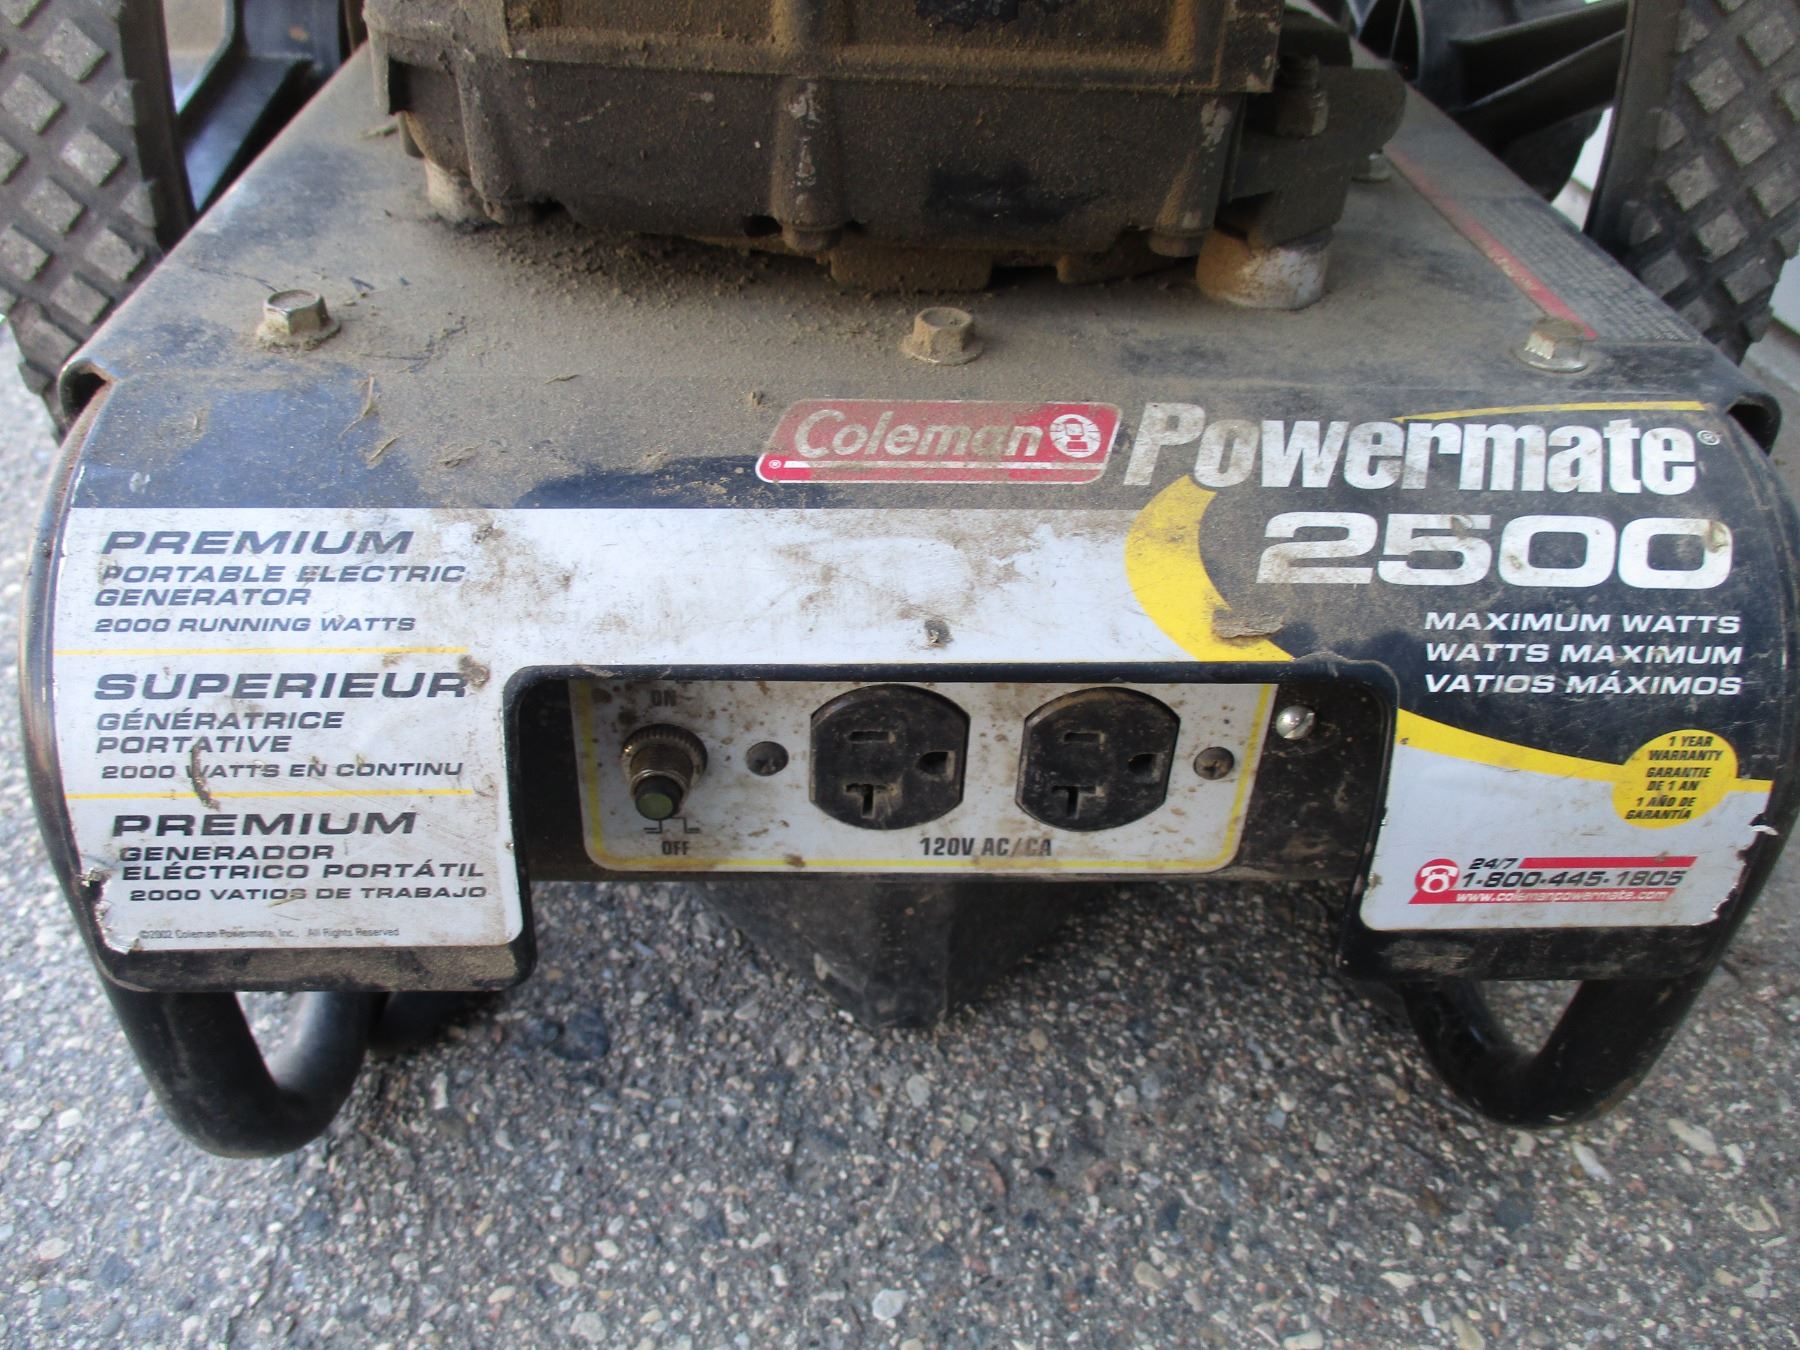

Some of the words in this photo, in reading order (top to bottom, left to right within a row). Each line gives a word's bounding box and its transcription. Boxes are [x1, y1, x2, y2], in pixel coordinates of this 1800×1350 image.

[794, 409, 1043, 457] Coleman
[102, 531, 414, 554] PREMIUM
[1256, 511, 1734, 590] 2500
[101, 566, 286, 583] PORTABLE
[298, 565, 466, 582] ELECTRIC
[95, 588, 312, 606] GENERATOR
[95, 618, 170, 632] 2000
[178, 618, 311, 632] RUNNING
[321, 617, 416, 631] WATTS
[1424, 612, 1607, 632] MAXIMUM
[1623, 614, 1742, 634] WATTS
[1426, 643, 1550, 663] WATTS
[1560, 644, 1743, 665] MAXIMUM
[1425, 674, 1556, 694] VATIOS
[1566, 669, 1742, 695] MÁXIMOS
[651, 690, 676, 706] ON
[97, 707, 345, 730] GÉNÉRATRICE
[96, 736, 292, 753] PORTATIVE
[1669, 736, 1677, 747] 1
[1681, 736, 1714, 747] YEAR
[1648, 750, 1723, 761] WARRANTY
[102, 765, 175, 779] 2000
[186, 764, 280, 779] WATTS
[289, 764, 327, 777] EN
[336, 763, 463, 777] CONTINU
[1646, 767, 1712, 778] GARANTIE
[1647, 781, 1665, 791] DE
[1668, 781, 1676, 791] 1
[1679, 781, 1700, 791] AN
[1636, 797, 1644, 807] 1
[1679, 797, 1697, 807] DE
[112, 812, 417, 837] PREMIUM
[121, 845, 333, 861] GENERADOR
[662, 841, 690, 855] OFF
[920, 838, 974, 856] 120V
[981, 838, 1052, 857] AC/CA
[122, 862, 309, 880] ELÉCTRICO
[323, 859, 485, 879] PORTÁTIL
[1468, 858, 1518, 869] 24/7
[130, 889, 200, 901] 2000
[209, 888, 306, 901] VATIOS
[316, 888, 354, 900] DE
[361, 886, 487, 900] TRABAJO
[1456, 890, 1669, 902] www.colemanpowermate.com
[175, 930, 217, 939] Coleman
[323, 928, 353, 938] Rights
[356, 928, 399, 936] Reserved
